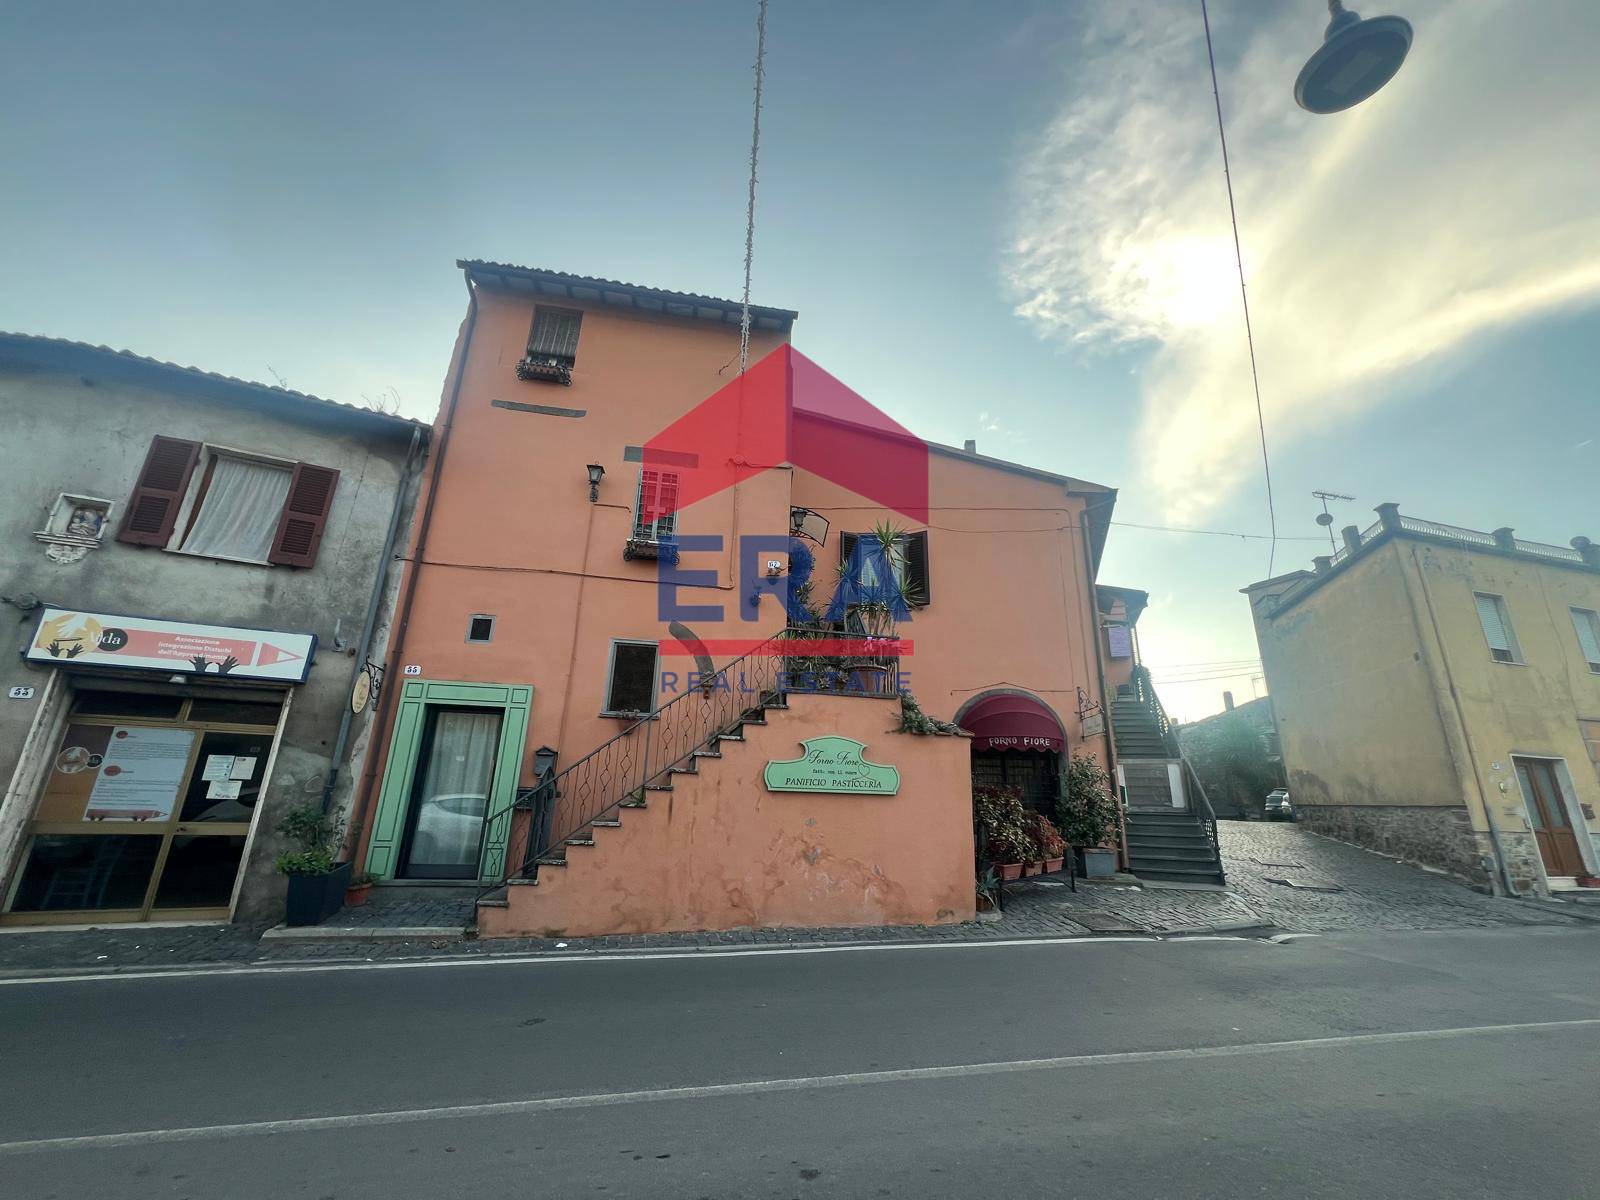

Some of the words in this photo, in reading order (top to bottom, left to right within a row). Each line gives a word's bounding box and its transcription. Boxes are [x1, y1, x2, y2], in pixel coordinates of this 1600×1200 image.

[175, 635, 220, 645] Associazione
[158, 641, 203, 652] Integrazione
[989, 736, 1018, 747] FORNO
[1023, 736, 1051, 747] FIORE
[808, 749, 835, 765] Forno
[836, 751, 859, 766] Fiore
[785, 777, 827, 787] PANIFICIO
[831, 779, 882, 789] PASTICCERIA
